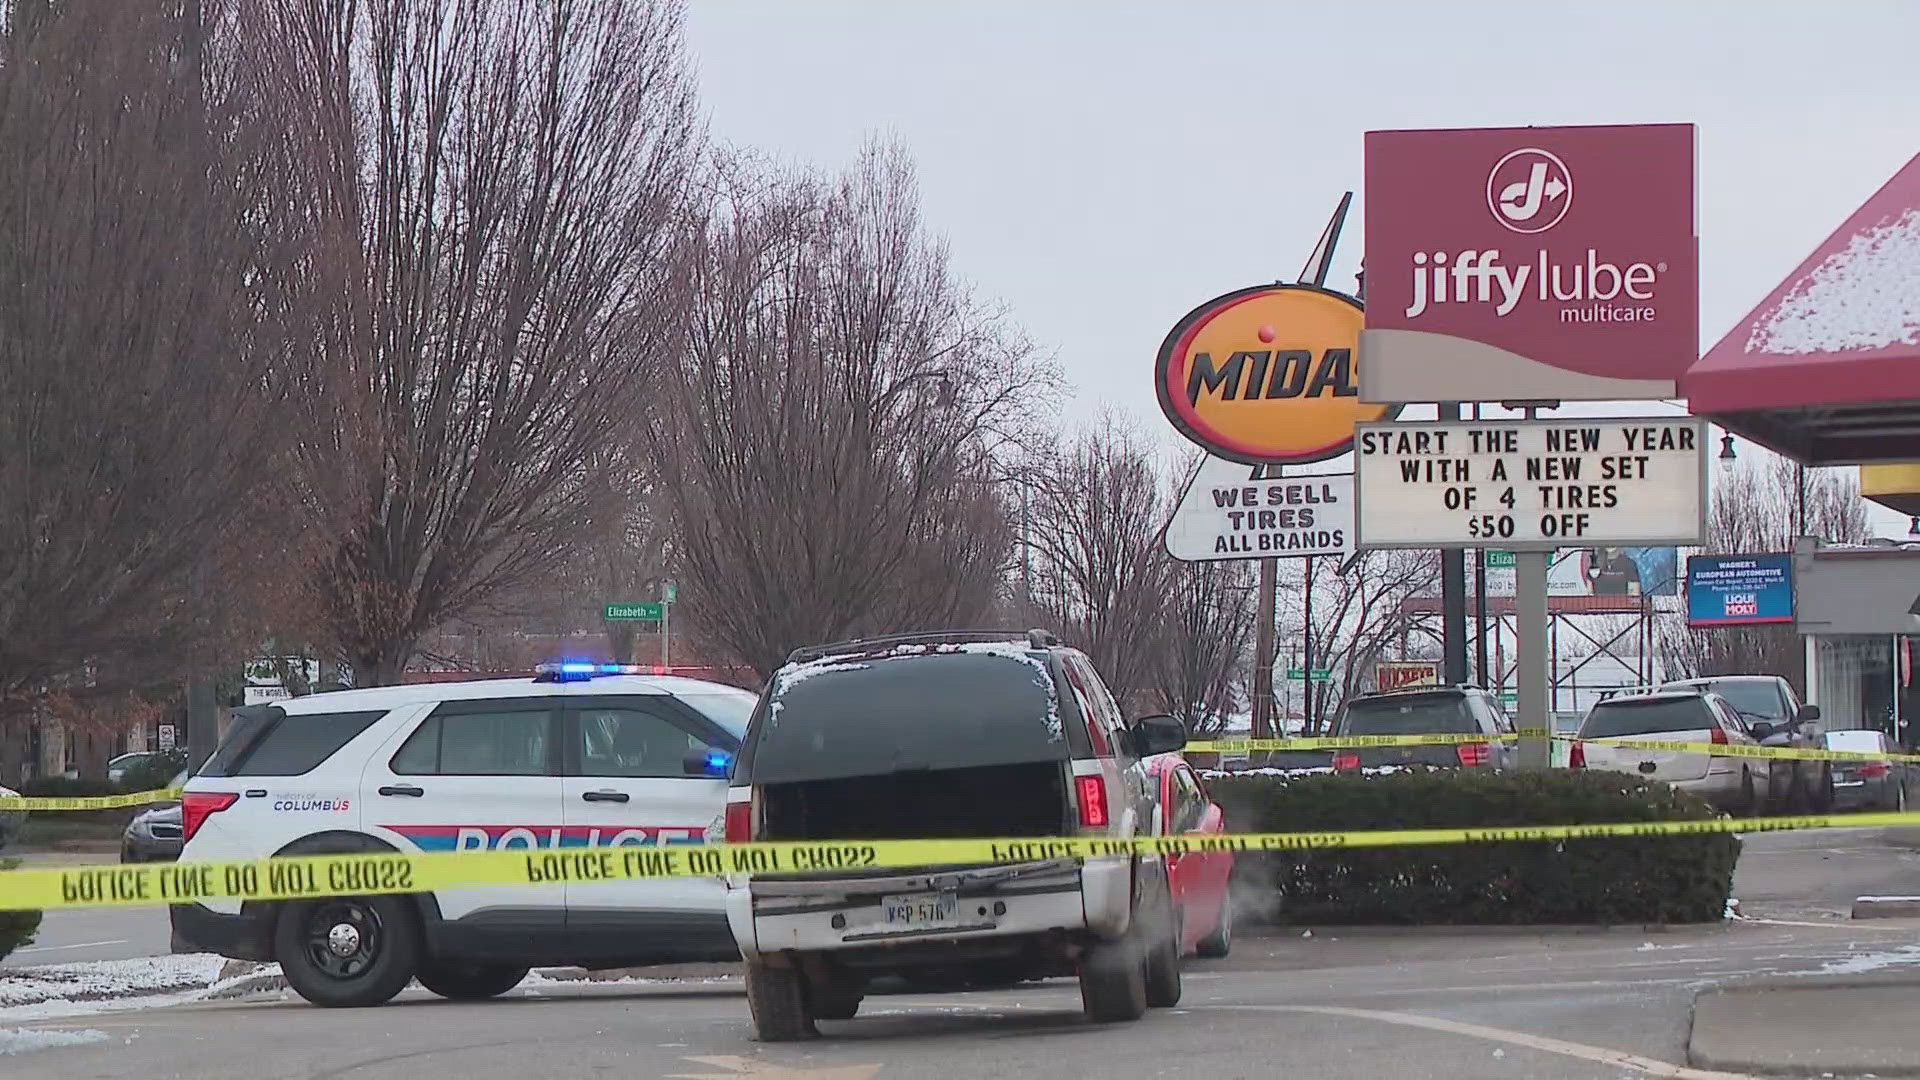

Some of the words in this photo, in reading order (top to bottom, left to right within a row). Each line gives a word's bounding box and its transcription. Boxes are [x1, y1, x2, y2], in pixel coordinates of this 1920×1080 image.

[1405, 249, 1532, 319] jiffy
[1560, 303, 1656, 323] multicare
[1186, 326, 1360, 409] MIDA
[1362, 431, 1449, 455] START
[1468, 429, 1519, 453] THE
[1545, 427, 1601, 453] NEW
[1622, 426, 1696, 451] YEAR
[1400, 458, 1471, 483] WITH
[1491, 457, 1508, 482] A
[1526, 456, 1582, 481] NEW
[1600, 455, 1650, 480] SET
[1212, 487, 1259, 508] WE
[1266, 483, 1338, 506] SELL
[1443, 486, 1478, 510] OF
[1499, 485, 1516, 510] 4
[1538, 484, 1619, 509] TIRES
[1227, 507, 1315, 531] TIRES
[1467, 514, 1516, 539] $50
[1539, 512, 1590, 537] OFF
[1214, 534, 1253, 554] ALL
[1257, 529, 1345, 552] BRANDS
[1695, 570, 1735, 579] EUROPEAN
[1736, 568, 1782, 578] AUTOMOTIVE
[1725, 593, 1755, 605] LIQUI
[1725, 604, 1757, 615] MOLY
[607, 606, 647, 618] Elizabeth
